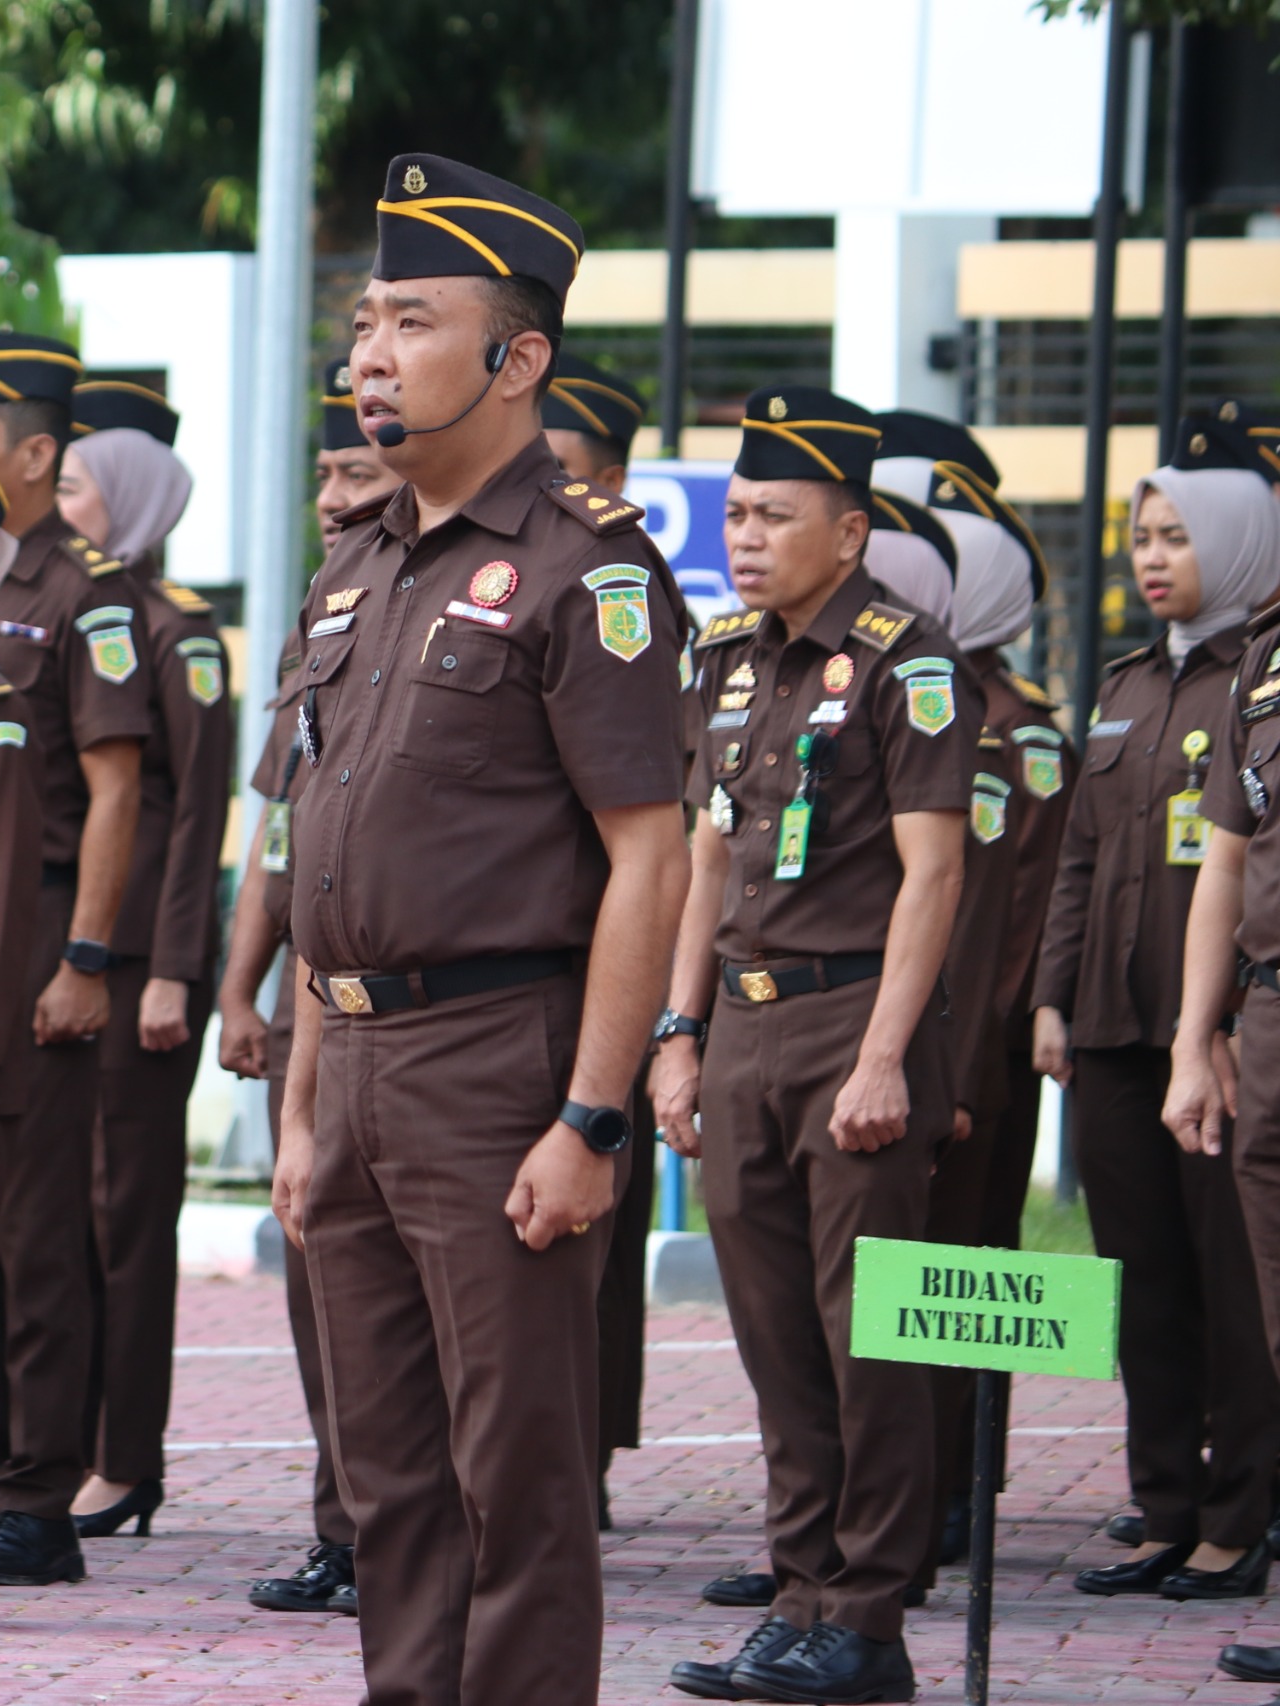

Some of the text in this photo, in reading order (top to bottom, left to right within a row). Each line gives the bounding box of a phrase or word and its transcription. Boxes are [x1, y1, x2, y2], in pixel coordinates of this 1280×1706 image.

[597, 506, 635, 524] JAKSA
[921, 1266, 1044, 1305] BIDANG
[897, 1307, 1069, 1349] INTELIJEN
